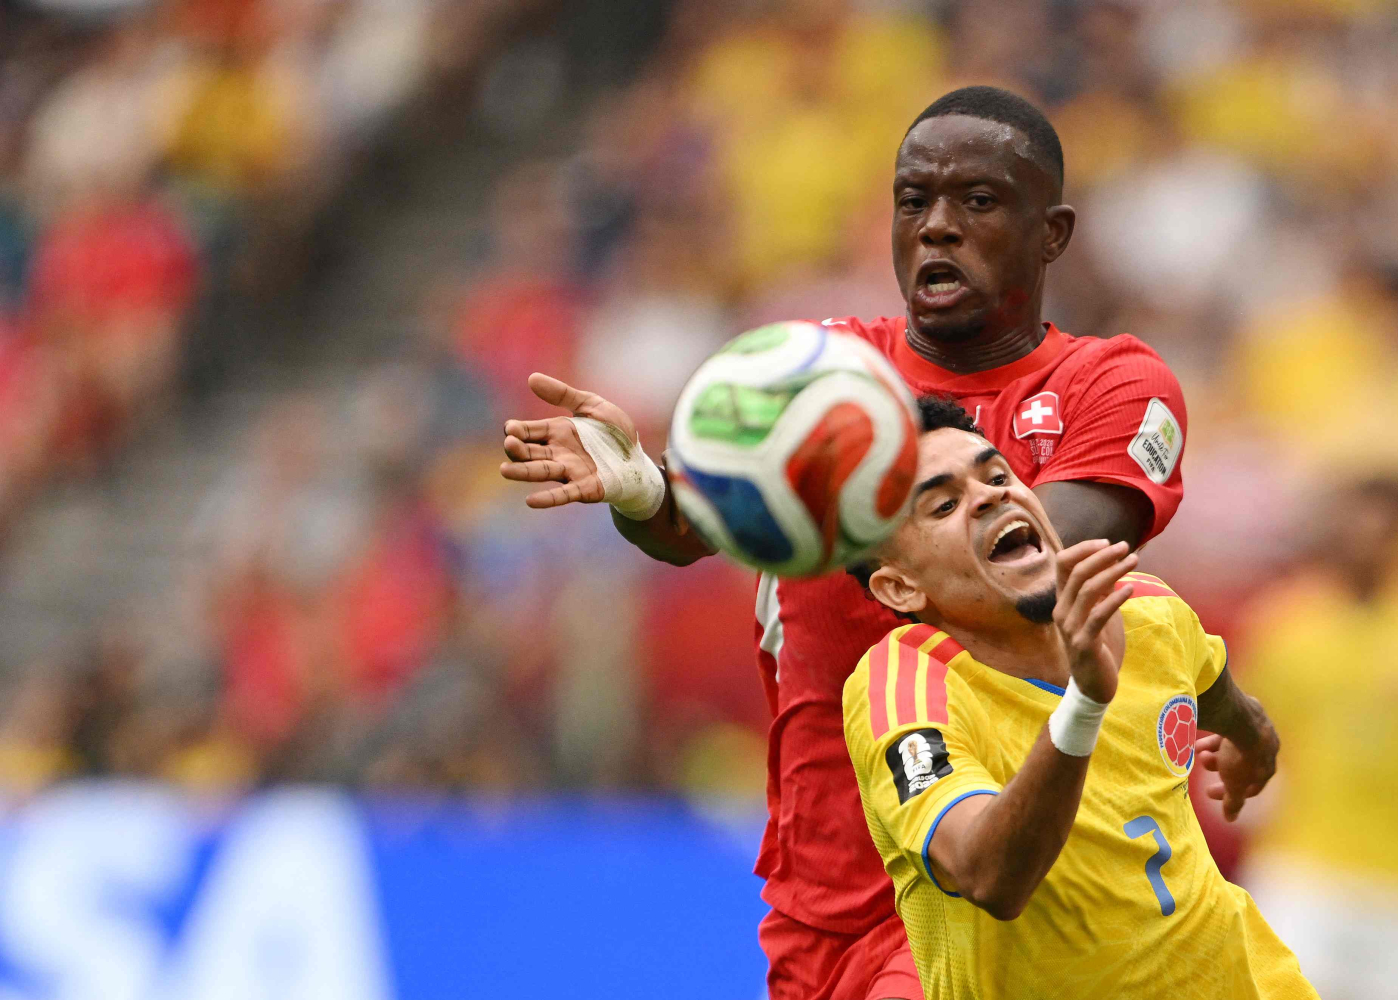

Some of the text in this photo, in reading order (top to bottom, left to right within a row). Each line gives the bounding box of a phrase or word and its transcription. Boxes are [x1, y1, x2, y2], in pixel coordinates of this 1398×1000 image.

[1142, 438, 1167, 476] EDUCATION
[1146, 458, 1155, 472] FIFA
[1123, 815, 1176, 916] 7
